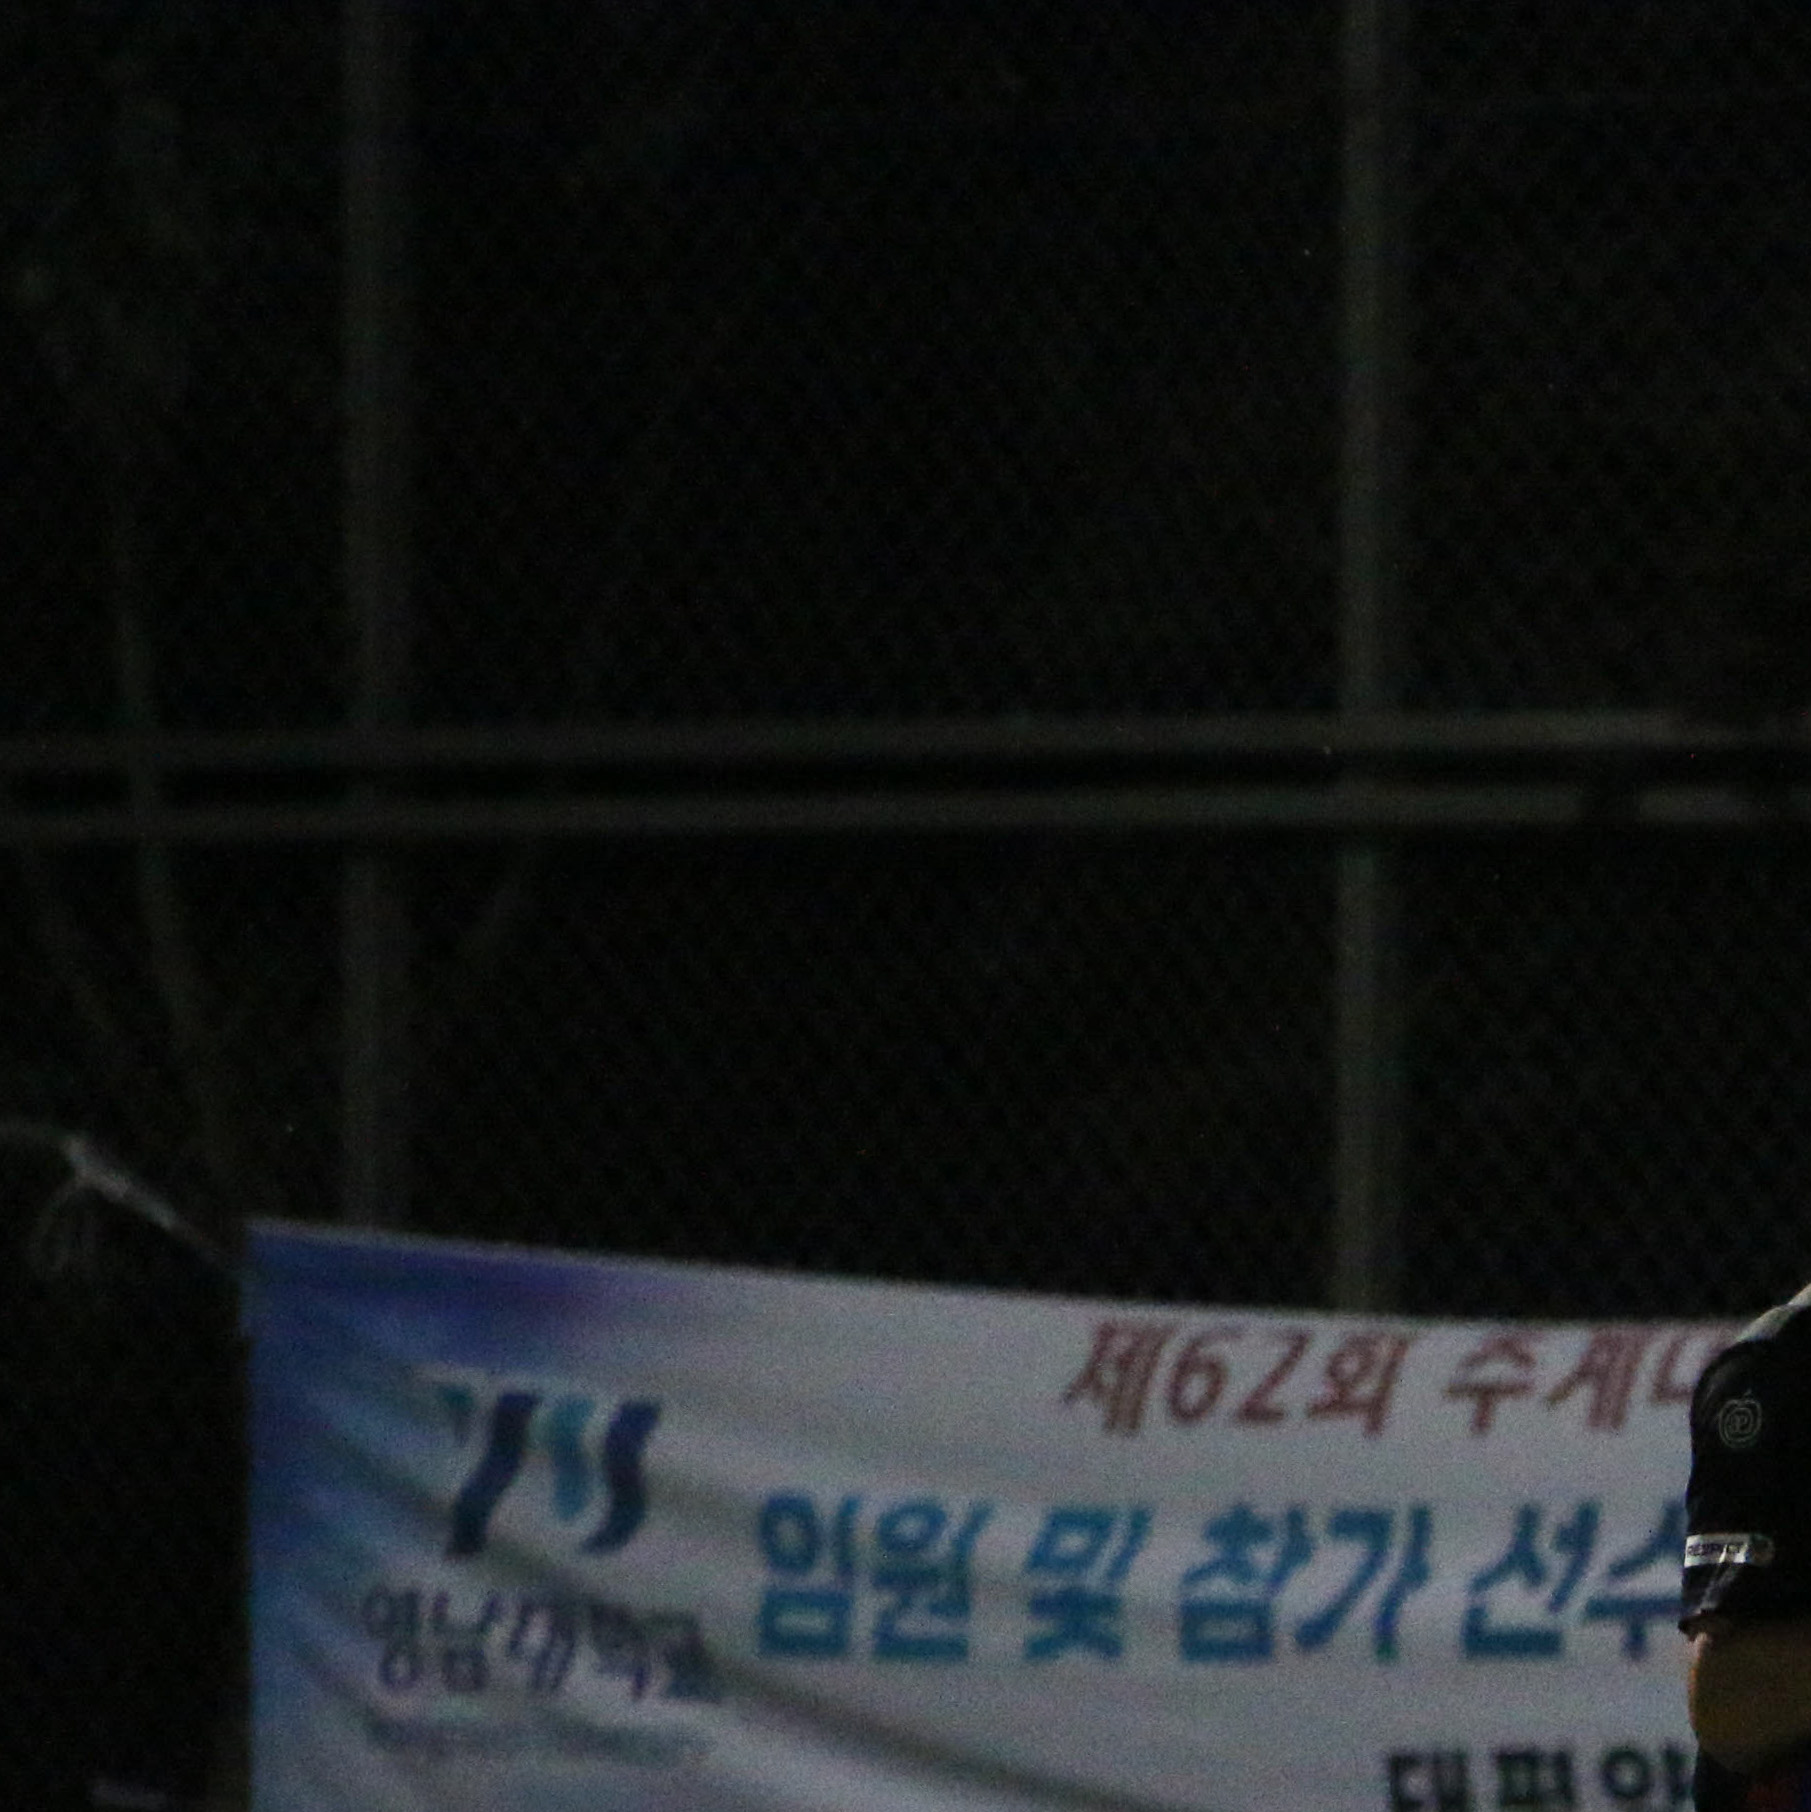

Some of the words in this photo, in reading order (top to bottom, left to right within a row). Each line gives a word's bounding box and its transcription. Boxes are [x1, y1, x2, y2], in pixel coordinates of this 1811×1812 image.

[1062, 1320, 1410, 1436] 제62회
[757, 1488, 995, 1662] 임원
[1021, 1500, 1153, 1663] 및
[1179, 1500, 1433, 1665] 참가
